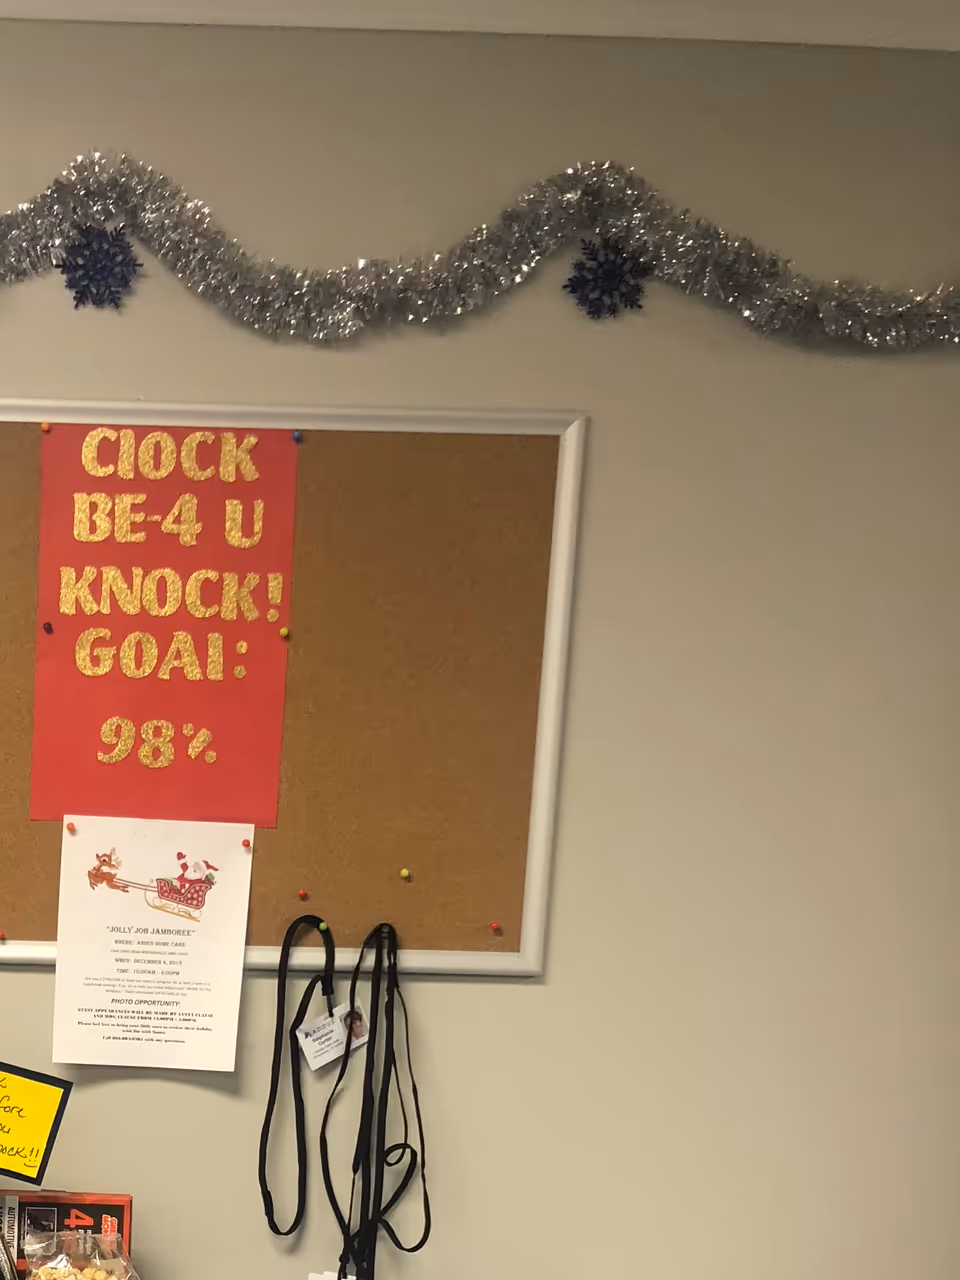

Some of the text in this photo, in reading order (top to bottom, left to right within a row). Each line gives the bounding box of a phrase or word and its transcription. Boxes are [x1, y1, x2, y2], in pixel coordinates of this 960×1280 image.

[73, 492, 265, 549] BE-4 U
[59, 566, 283, 623] KNOCK!
[96, 716, 217, 769] 98%
[134, 927, 149, 935] JOB
[110, 998, 134, 1006] PHOTO
